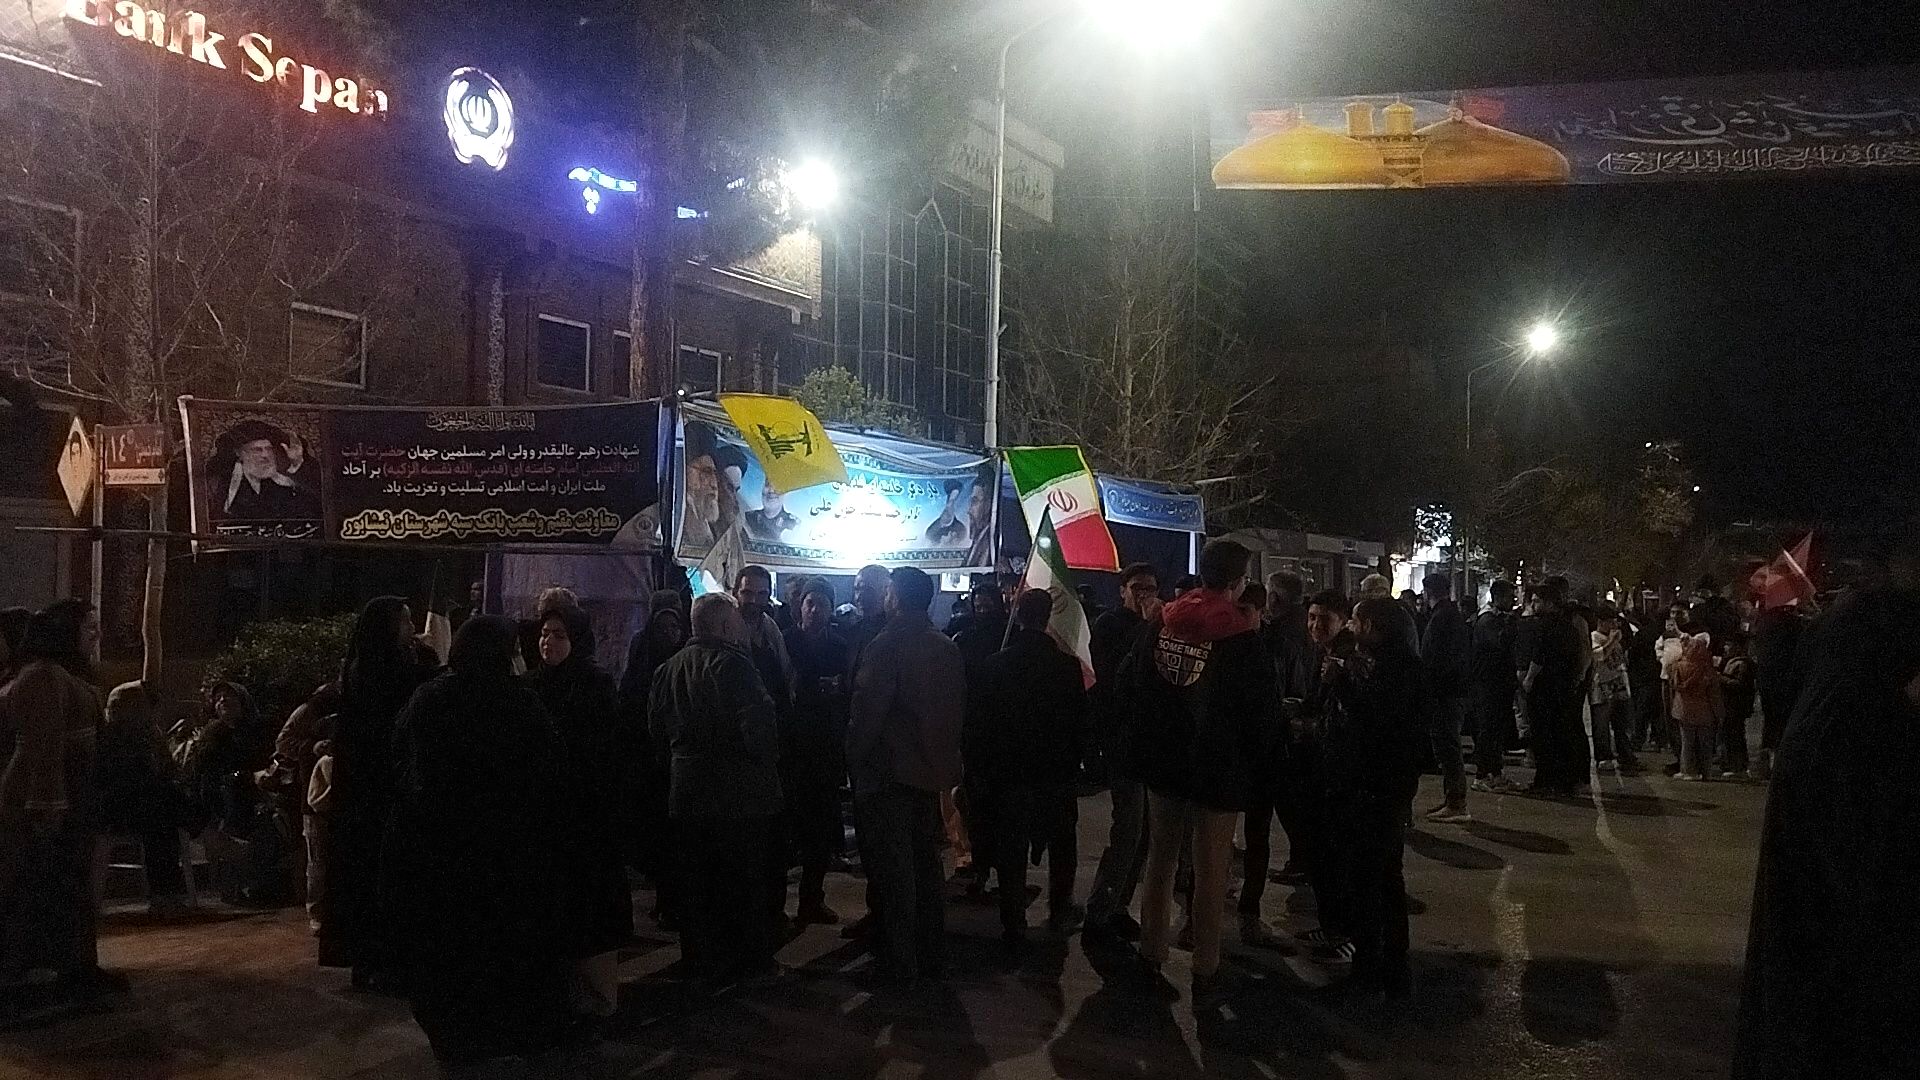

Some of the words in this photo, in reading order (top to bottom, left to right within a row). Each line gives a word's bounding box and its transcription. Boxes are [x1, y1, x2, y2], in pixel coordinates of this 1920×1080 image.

[407, 444, 439, 461] جهان
[440, 445, 487, 461] مسلمین
[488, 444, 505, 461] امر
[508, 444, 529, 460] ولی
[538, 444, 575, 460] عالیقدر
[576, 445, 601, 460] رهبر
[602, 443, 640, 457] شهادت
[342, 460, 367, 475] آحاد
[369, 465, 382, 479] بر
[404, 481, 438, 497] تعزیت
[447, 480, 486, 496] تسلیت
[487, 479, 525, 496] اسلامی
[526, 479, 549, 493] امت
[558, 479, 581, 496] ایران
[582, 479, 607, 493] ملت
[340, 508, 392, 539] نیشابور
[392, 508, 449, 538] شهرستان
[474, 508, 507, 537] بانک
[574, 507, 621, 537] معاونت
